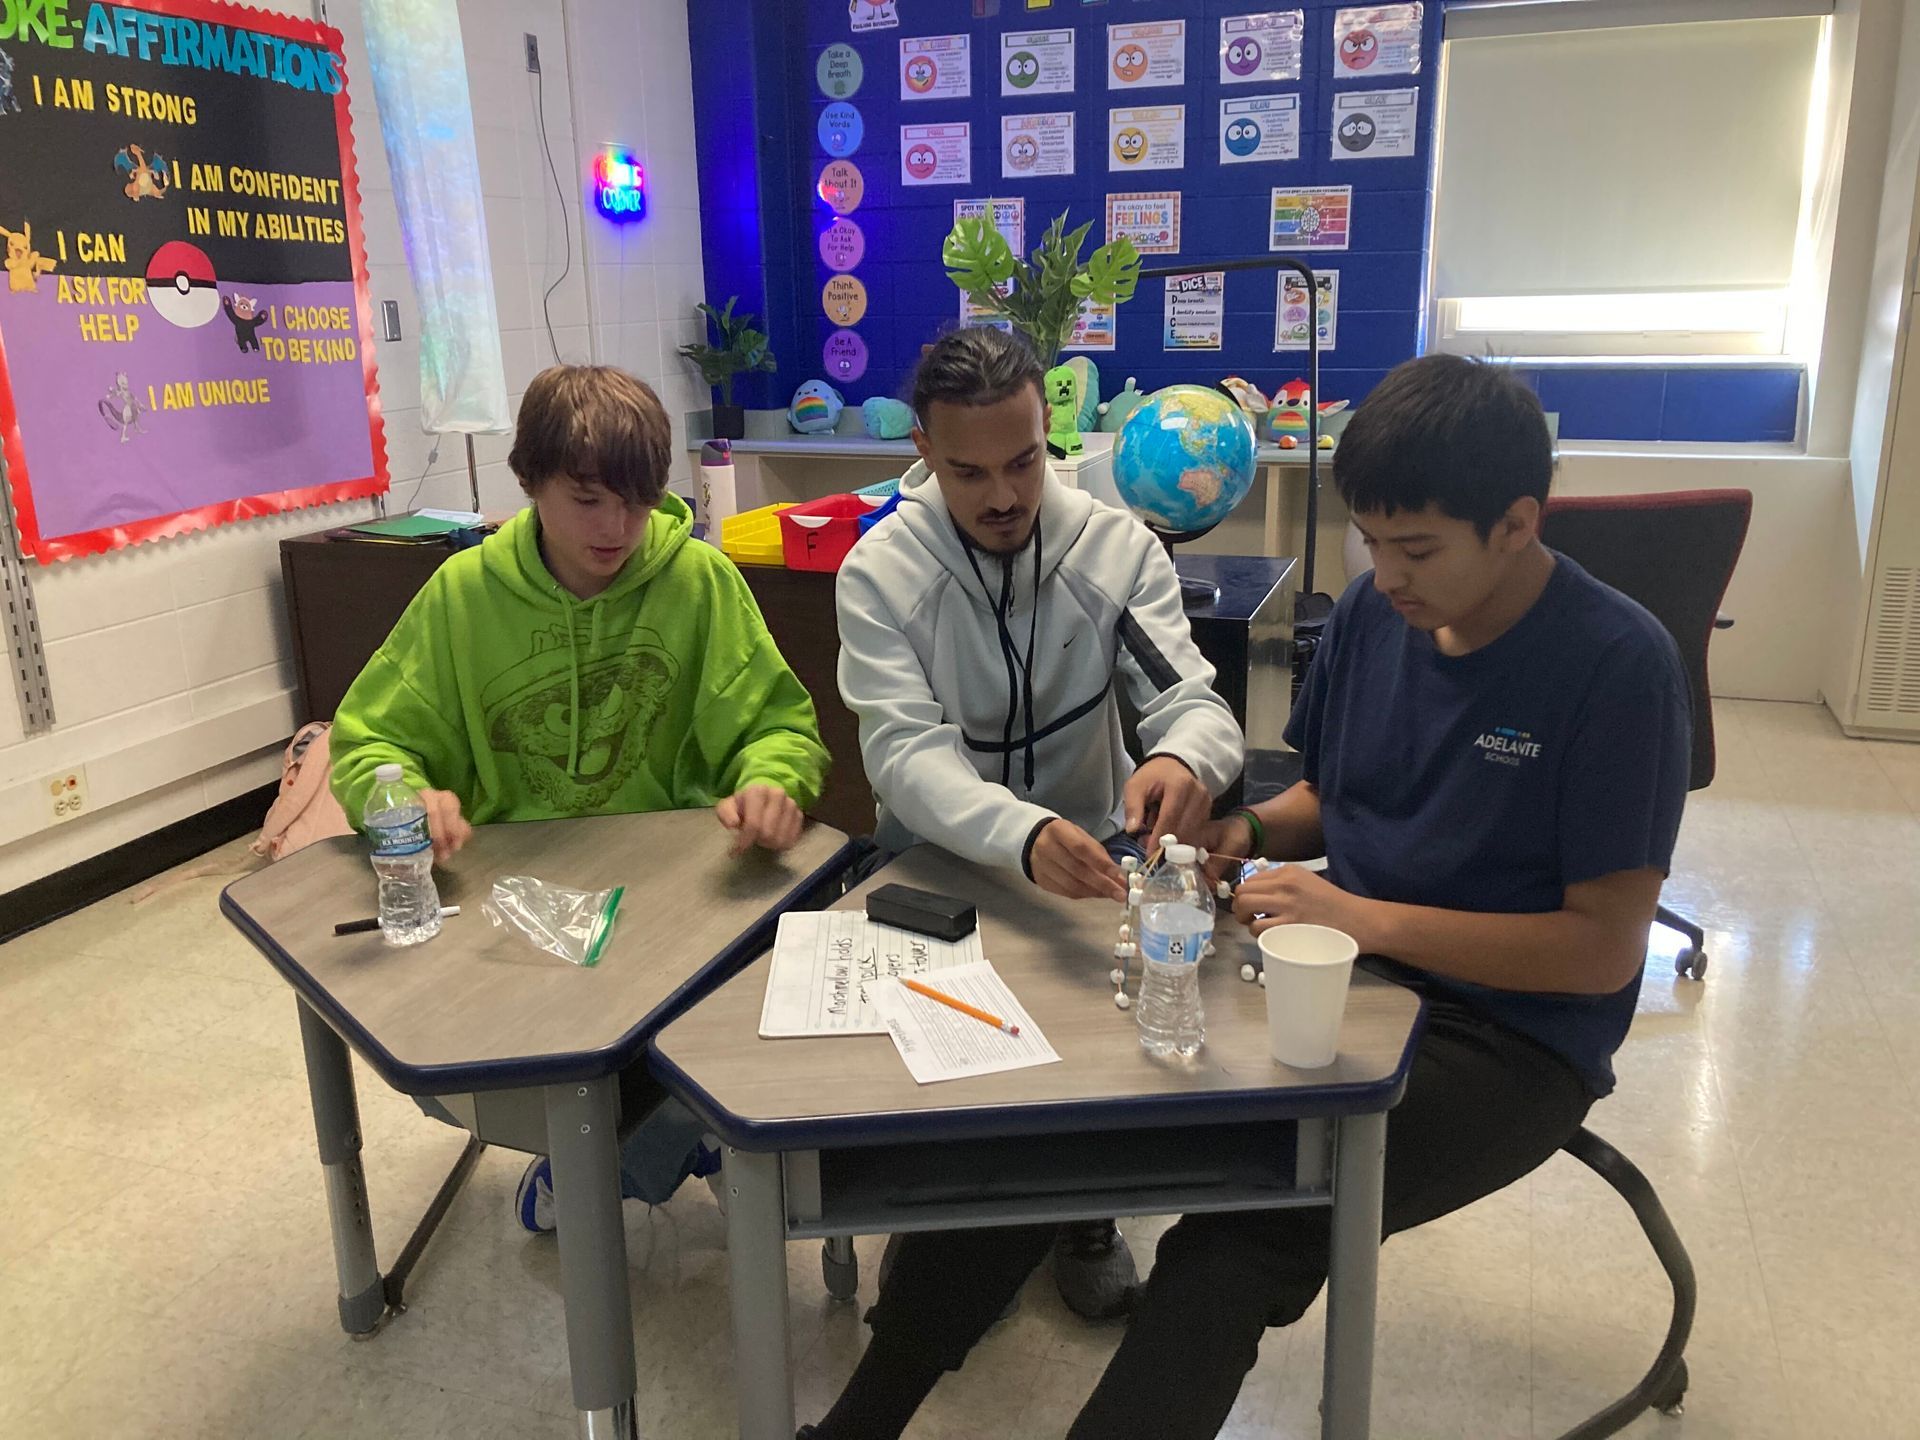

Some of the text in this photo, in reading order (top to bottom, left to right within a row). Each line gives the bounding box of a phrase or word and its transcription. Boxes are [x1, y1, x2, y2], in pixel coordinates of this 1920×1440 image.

[828, 50, 844, 59] Take
[830, 60, 848, 69] Deep
[828, 70, 852, 78] Breath
[33, 75, 197, 125] I AM STRONG
[825, 111, 839, 119] Use
[172, 160, 340, 206] I AM CONFIDENT
[832, 168, 848, 177] Talk
[187, 207, 345, 244] IN MY ABILITIES
[57, 231, 126, 263] I CAN
[57, 276, 148, 305] ASK FOR
[828, 291, 858, 300] Positive
[832, 281, 853, 289] Think
[1181, 276, 1203, 291] DICE
[79, 314, 140, 343] HELP
[270, 304, 352, 331] I CHOOSE
[261, 337, 357, 365] TO BE KIND
[149, 378, 271, 411] I AM UNIQUE
[806, 531, 819, 560] F
[1473, 733, 1543, 757] ADELANTE
